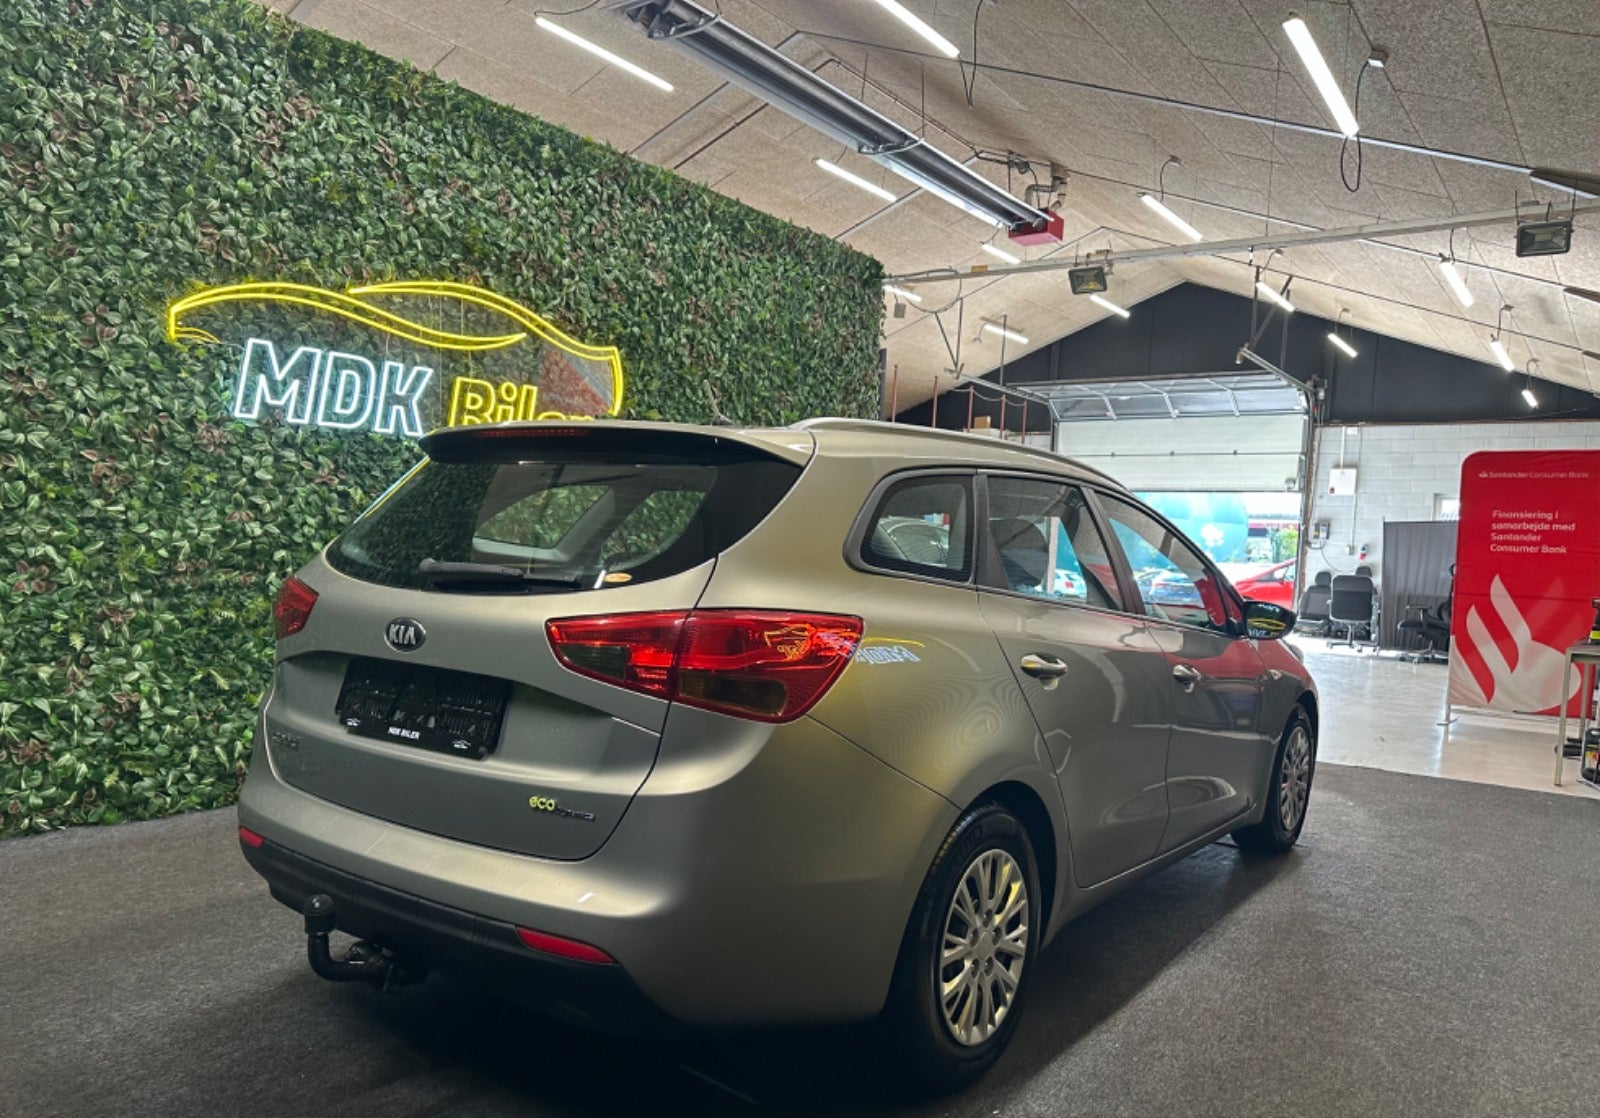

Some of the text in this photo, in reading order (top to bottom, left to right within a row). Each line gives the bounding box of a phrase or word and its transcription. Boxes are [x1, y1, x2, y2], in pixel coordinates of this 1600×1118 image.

[234, 337, 595, 436] MDK Bil
[1492, 510, 1553, 520] Finansiering
[1491, 521, 1576, 532] samarbejde med
[1491, 533, 1542, 541] Santander
[1490, 544, 1567, 553] Consumer Bank
[389, 623, 416, 645] KIA
